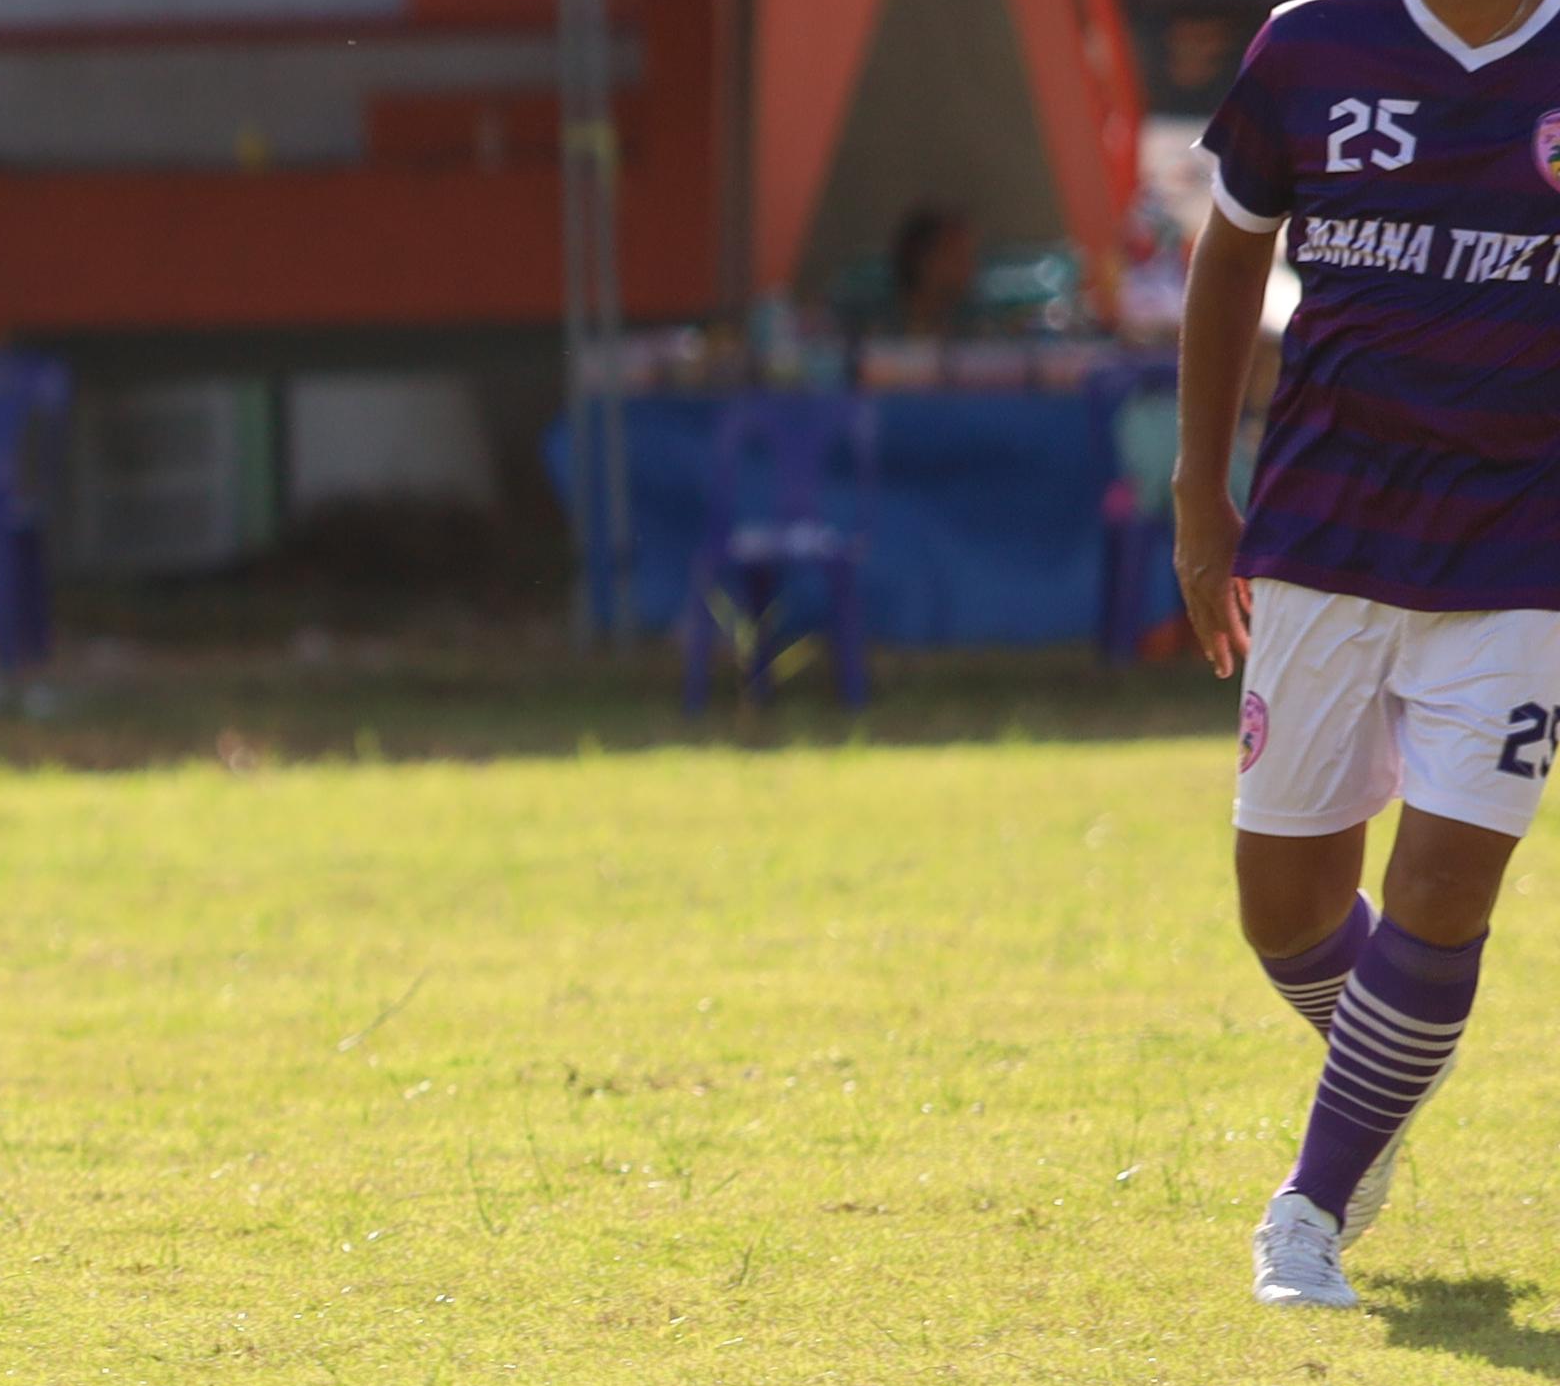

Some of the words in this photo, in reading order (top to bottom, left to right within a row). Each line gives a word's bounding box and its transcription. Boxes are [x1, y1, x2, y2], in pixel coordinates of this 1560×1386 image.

[1325, 97, 1420, 173] 25
[1442, 228, 1551, 284] TREE
[1495, 700, 1560, 781] 2
